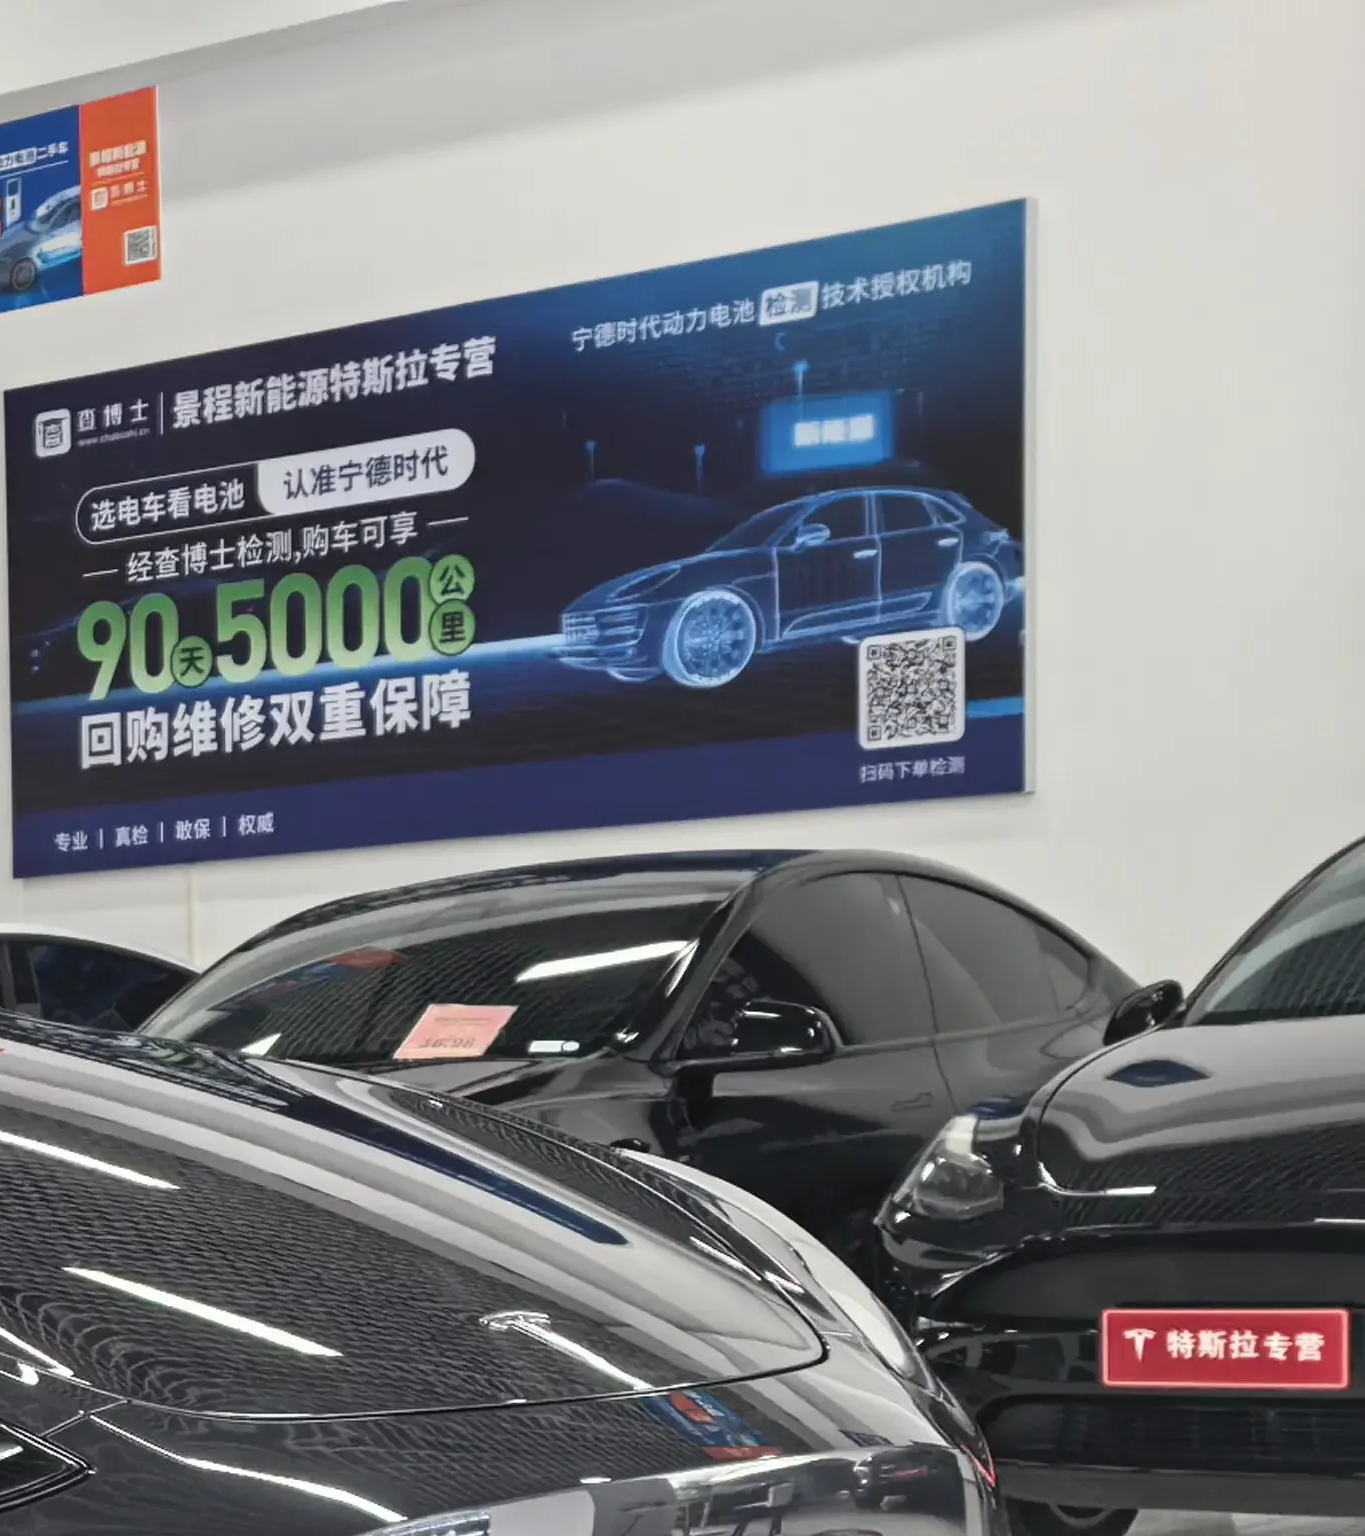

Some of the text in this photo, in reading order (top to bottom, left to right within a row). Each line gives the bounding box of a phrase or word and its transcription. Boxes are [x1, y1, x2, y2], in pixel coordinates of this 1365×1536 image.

[172, 336, 498, 429] 景程新能源特斯拉专营
[90, 445, 449, 531] 选电车看电池 认准宁德时代
[80, 669, 472, 769] 回购维修双重保障
[53, 811, 275, 853] 专业 真检 敢保 权威
[1165, 1328, 1327, 1363] 特斯拉专营
